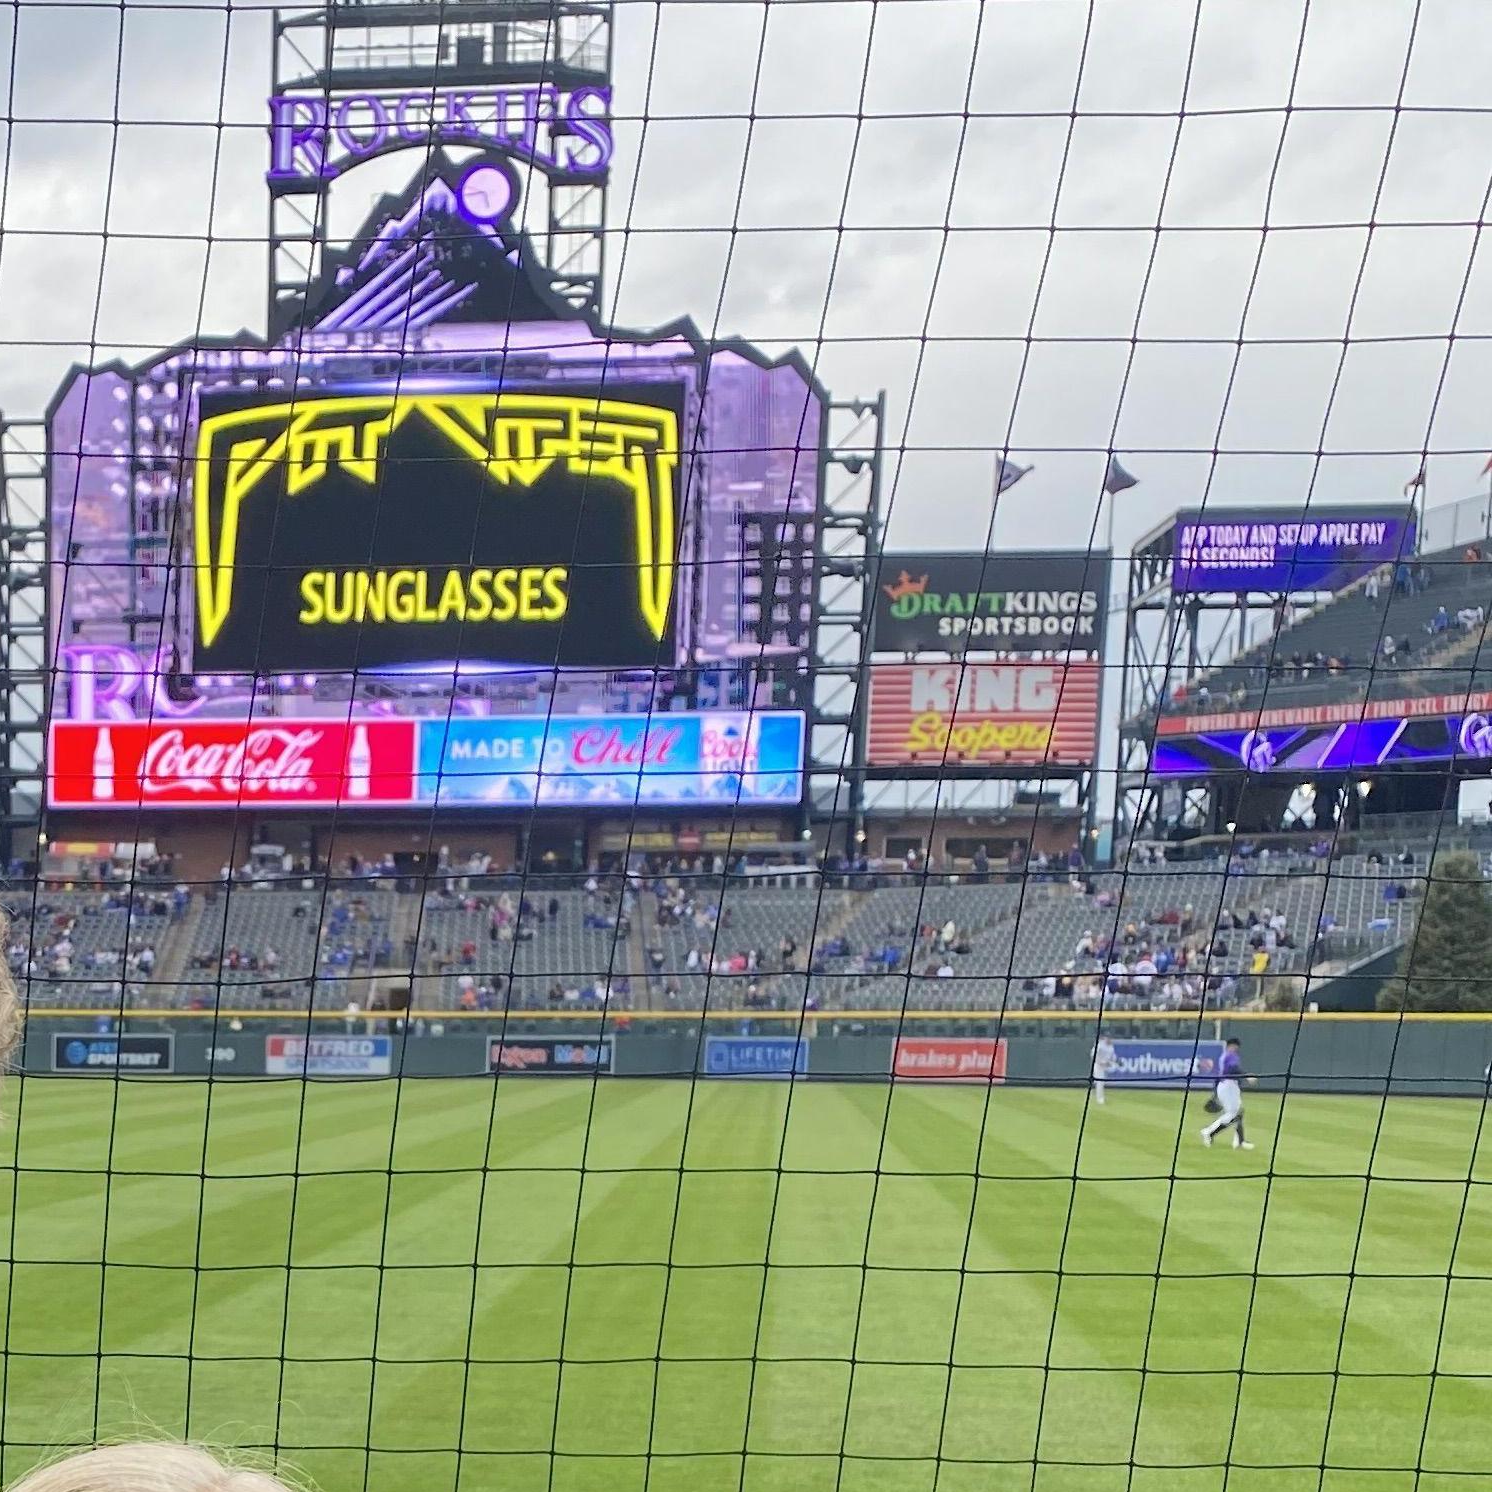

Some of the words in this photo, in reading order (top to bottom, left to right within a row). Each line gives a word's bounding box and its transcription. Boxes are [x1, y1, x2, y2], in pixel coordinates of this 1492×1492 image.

[267, 85, 615, 180] ROCKIES
[1209, 525, 1249, 547] TODAY
[1249, 525, 1277, 546] AND
[1319, 523, 1359, 546] APPLE
[1360, 522, 1386, 545] PAY
[298, 566, 568, 624] SUNGLASSES
[890, 591, 1098, 619] DRAFTKINGS
[938, 616, 1095, 636] SPORTSBOOK
[910, 668, 1058, 712] KING
[450, 738, 524, 760] MADE
[534, 737, 566, 760] TO
[571, 726, 683, 766] Chill
[905, 711, 1057, 759] Soopers
[137, 728, 325, 793] Coca-Cola
[900, 1049, 956, 1069] brakes
